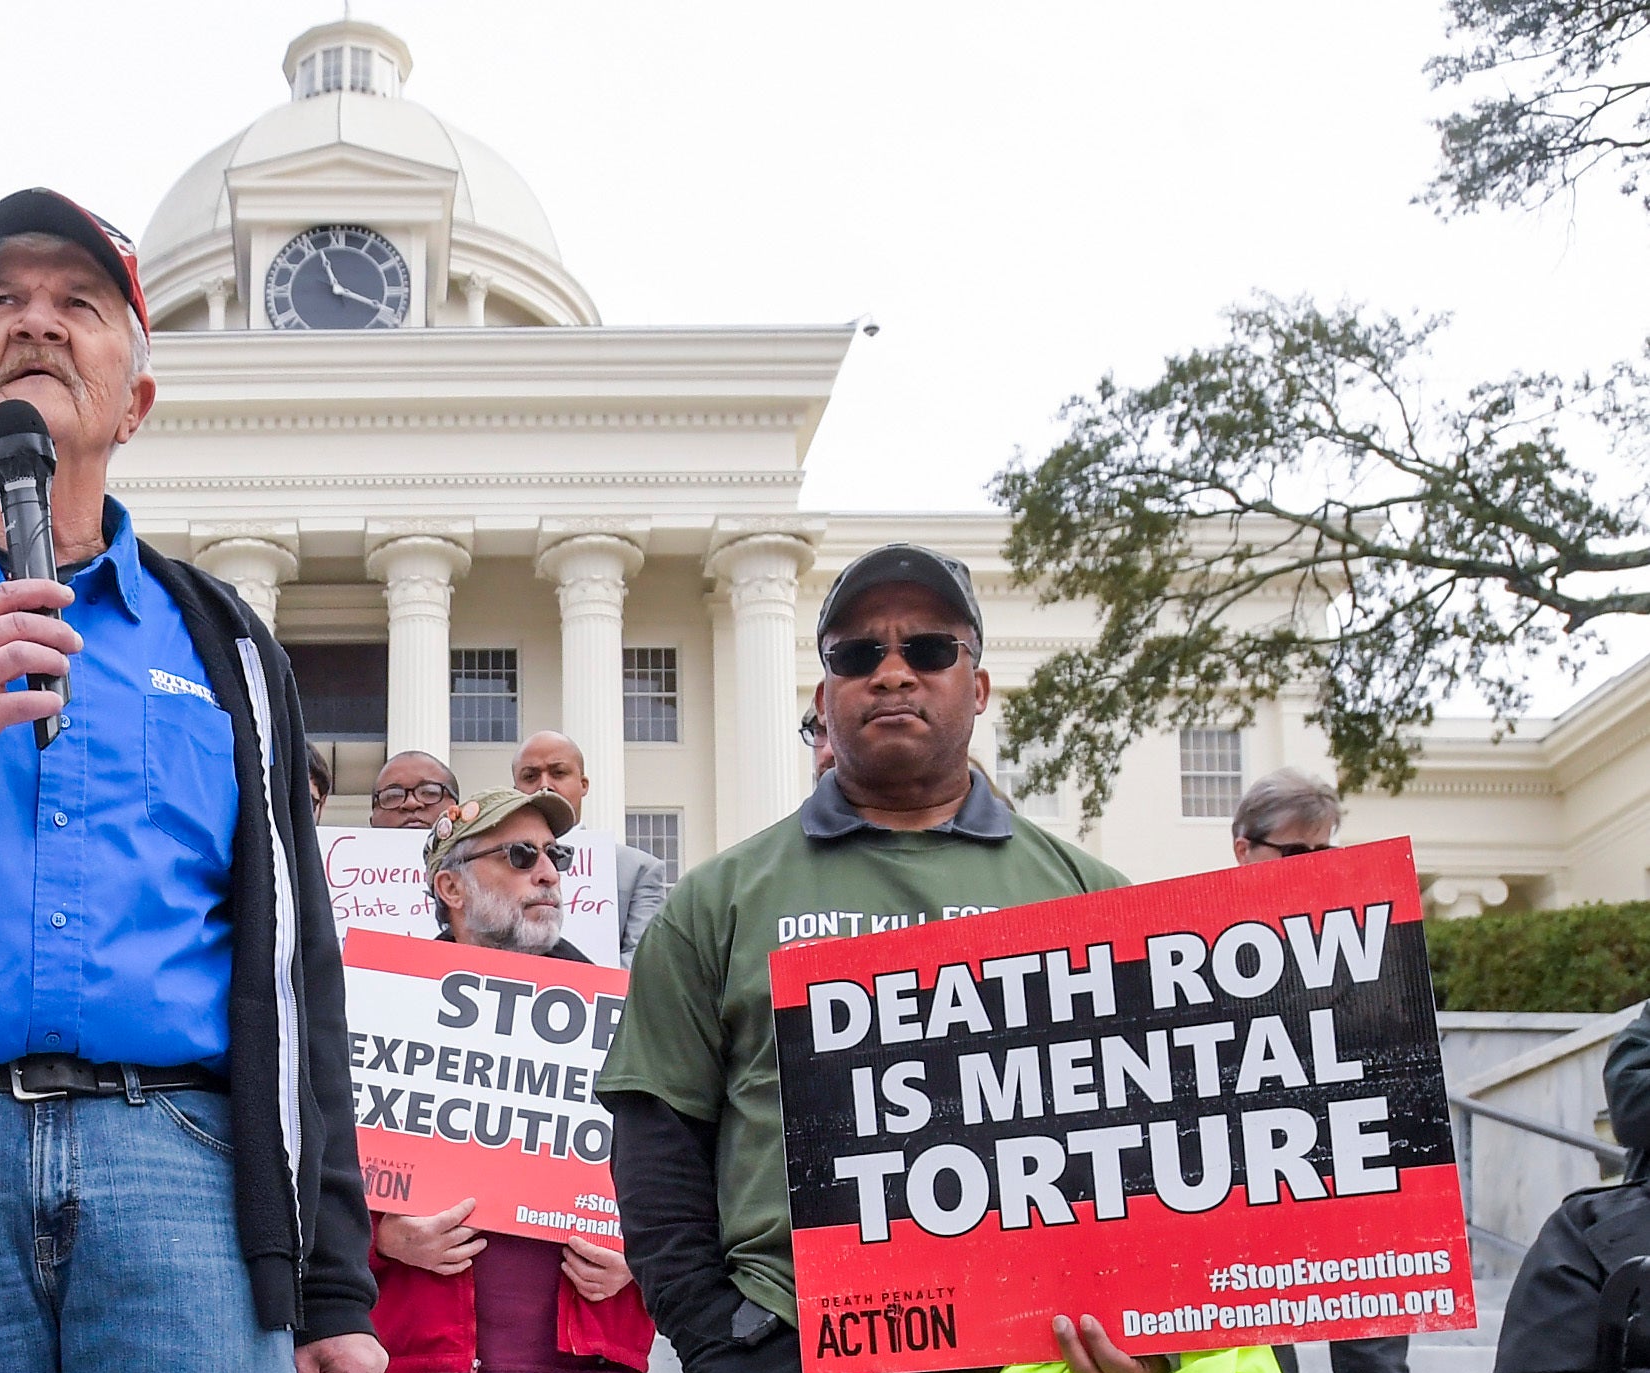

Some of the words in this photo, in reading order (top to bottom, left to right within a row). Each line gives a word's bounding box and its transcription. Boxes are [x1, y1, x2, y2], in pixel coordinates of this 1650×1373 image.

[326, 835, 427, 888] Govern
[565, 848, 592, 877] all
[332, 892, 397, 920] State
[563, 885, 614, 915] for
[778, 911, 864, 943] DON'T
[807, 943, 1115, 1054] DEATH
[1147, 902, 1392, 1013] ROW
[348, 1031, 602, 1105] EXPERIME
[852, 1061, 932, 1139] IS
[959, 1009, 1364, 1125] MENTAL
[351, 1082, 612, 1161] XECUTIO
[361, 1165, 412, 1202] ION
[366, 1156, 416, 1170] PENALTY
[835, 1097, 1399, 1243] TORTURE
[516, 1205, 624, 1239] DeathPenalt
[574, 1193, 620, 1217] #Sto
[1209, 1249, 1451, 1293] #StopExecutions
[821, 1294, 873, 1308] DEATH
[881, 1286, 956, 1303] PENALTY
[1122, 1287, 1455, 1337] DeathPenaltyAction.org
[817, 1303, 957, 1359] ACTION
